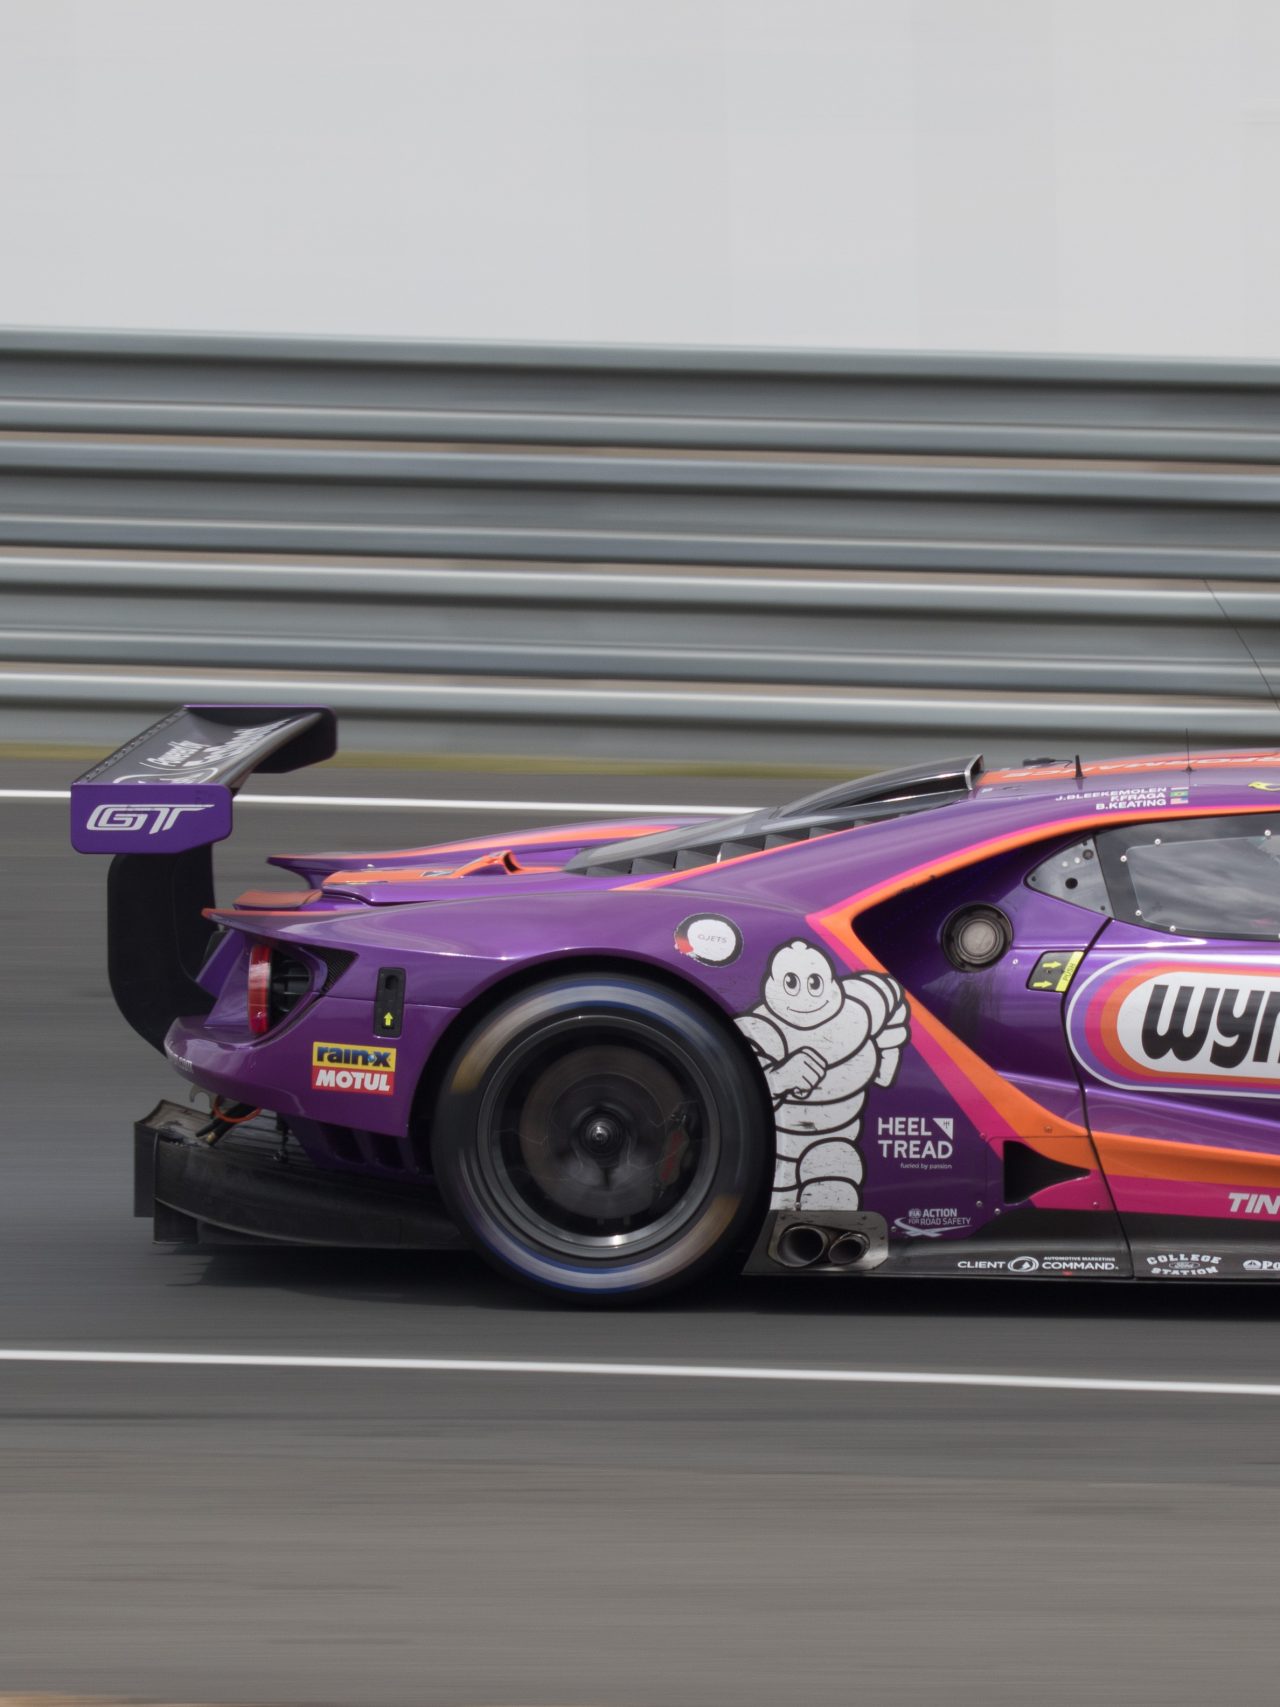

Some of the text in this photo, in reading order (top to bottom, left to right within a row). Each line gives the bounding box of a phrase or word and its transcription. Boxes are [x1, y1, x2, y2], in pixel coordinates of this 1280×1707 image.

[1055, 787, 1168, 801] J.BLEEKEMOLEN
[1095, 799, 1167, 810] B.KEATING
[86, 803, 215, 835] GT
[315, 1069, 390, 1092] MOTUL
[877, 1116, 932, 1136] HEEL
[877, 1140, 953, 1159] TREAD
[921, 1162, 929, 1171] by
[922, 1207, 958, 1218] ACTION
[908, 1216, 972, 1226] FOR ROAD SAFETY
[1146, 1253, 1222, 1265] COLLEGE
[957, 1261, 1006, 1269] CLIENT
[1150, 1266, 1219, 1276] STATION
